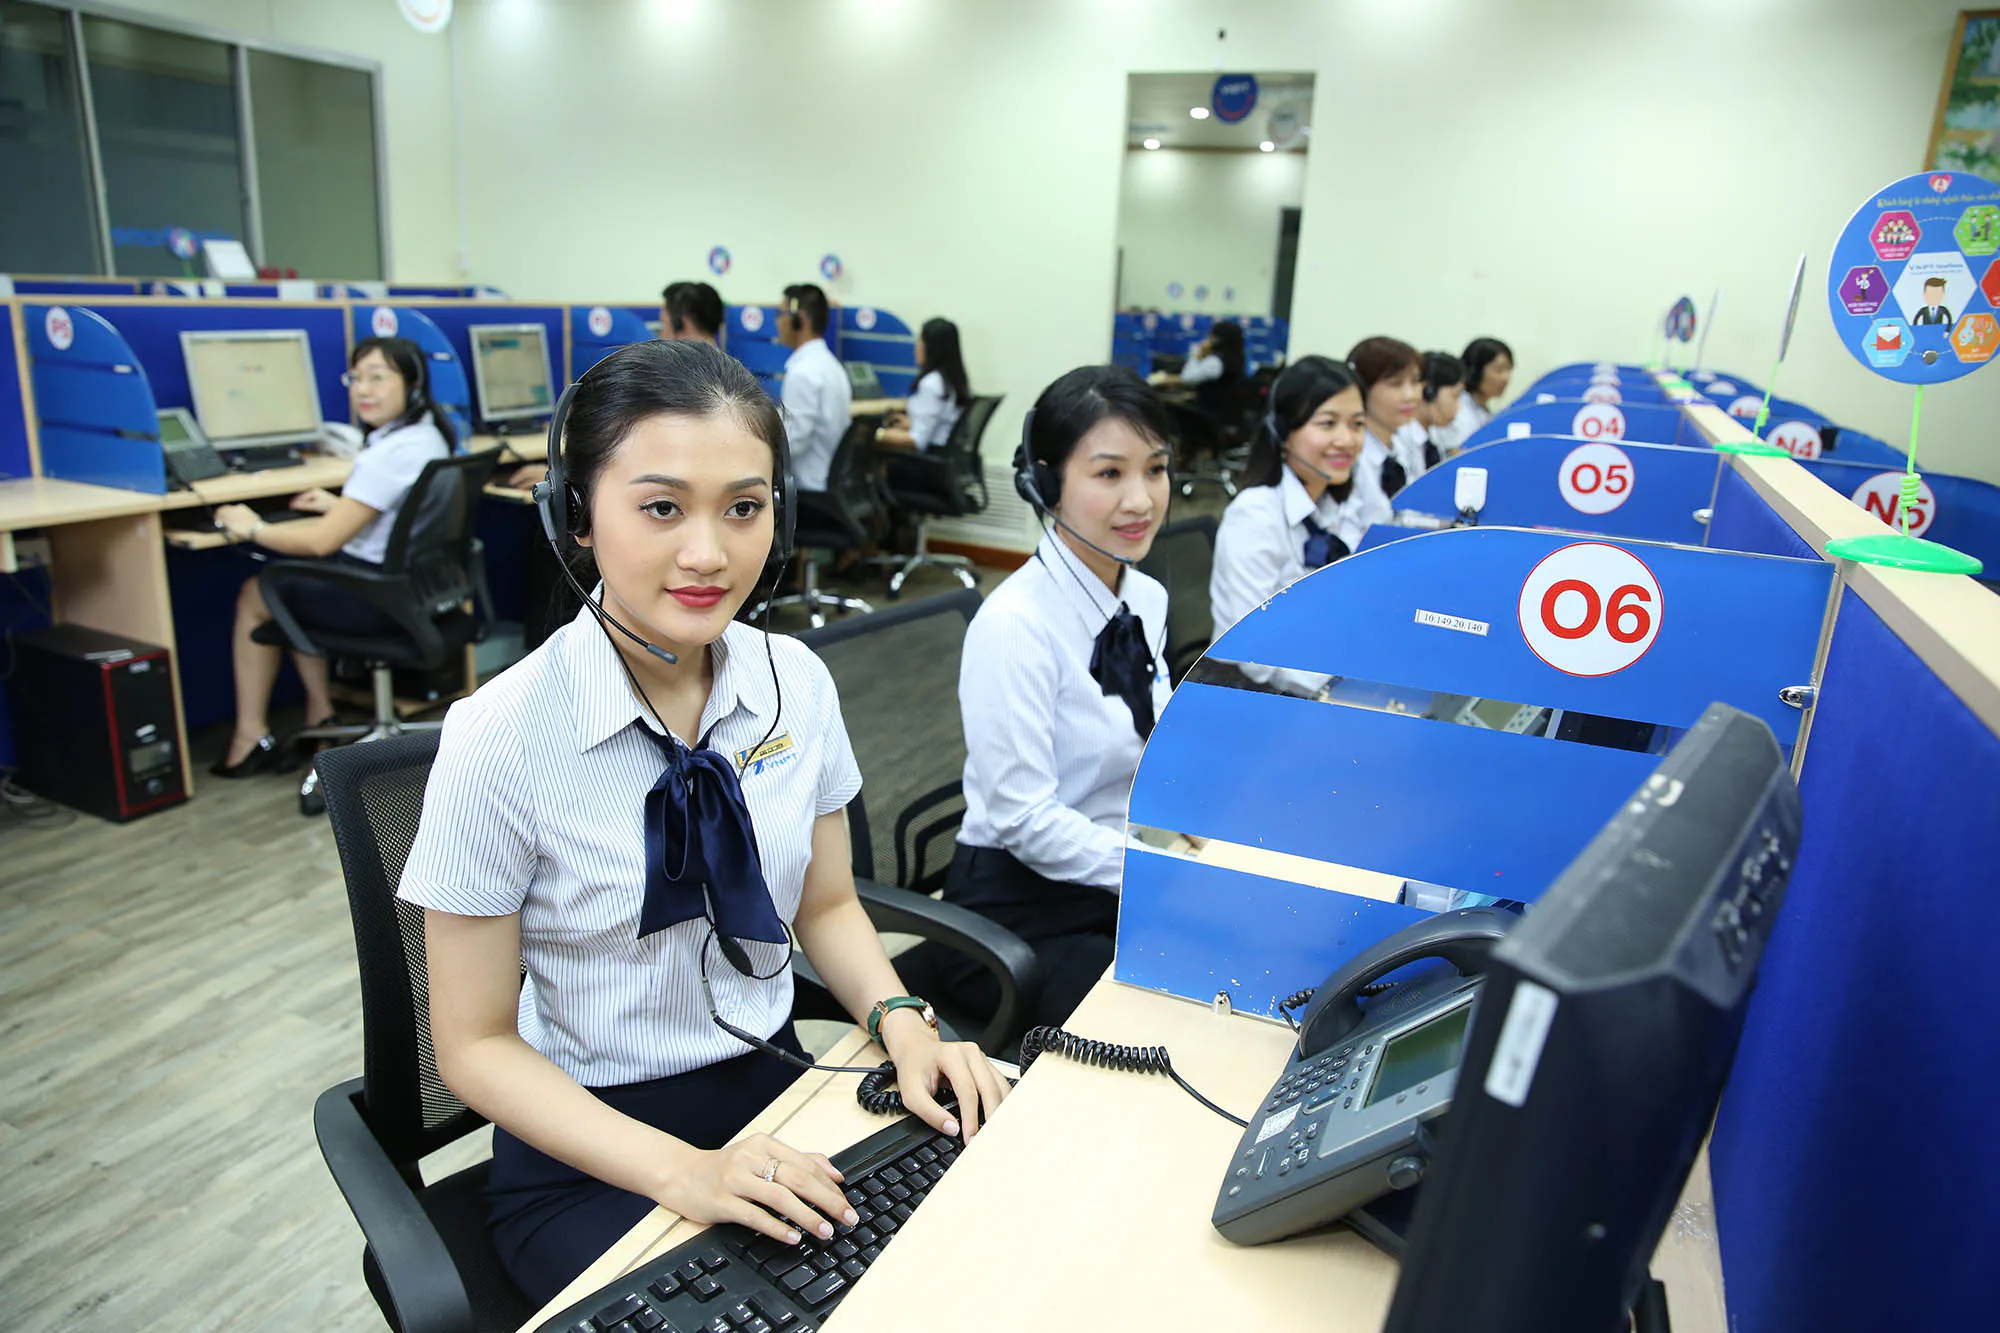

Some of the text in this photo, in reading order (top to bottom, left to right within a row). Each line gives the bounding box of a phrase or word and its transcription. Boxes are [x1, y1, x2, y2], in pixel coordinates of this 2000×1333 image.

[1582, 416, 1619, 439] O4
[1571, 463, 1628, 494] O5
[1865, 491, 1928, 529] N5
[1424, 613, 1483, 632] 10.149.20.140
[1541, 579, 1652, 643] O6
